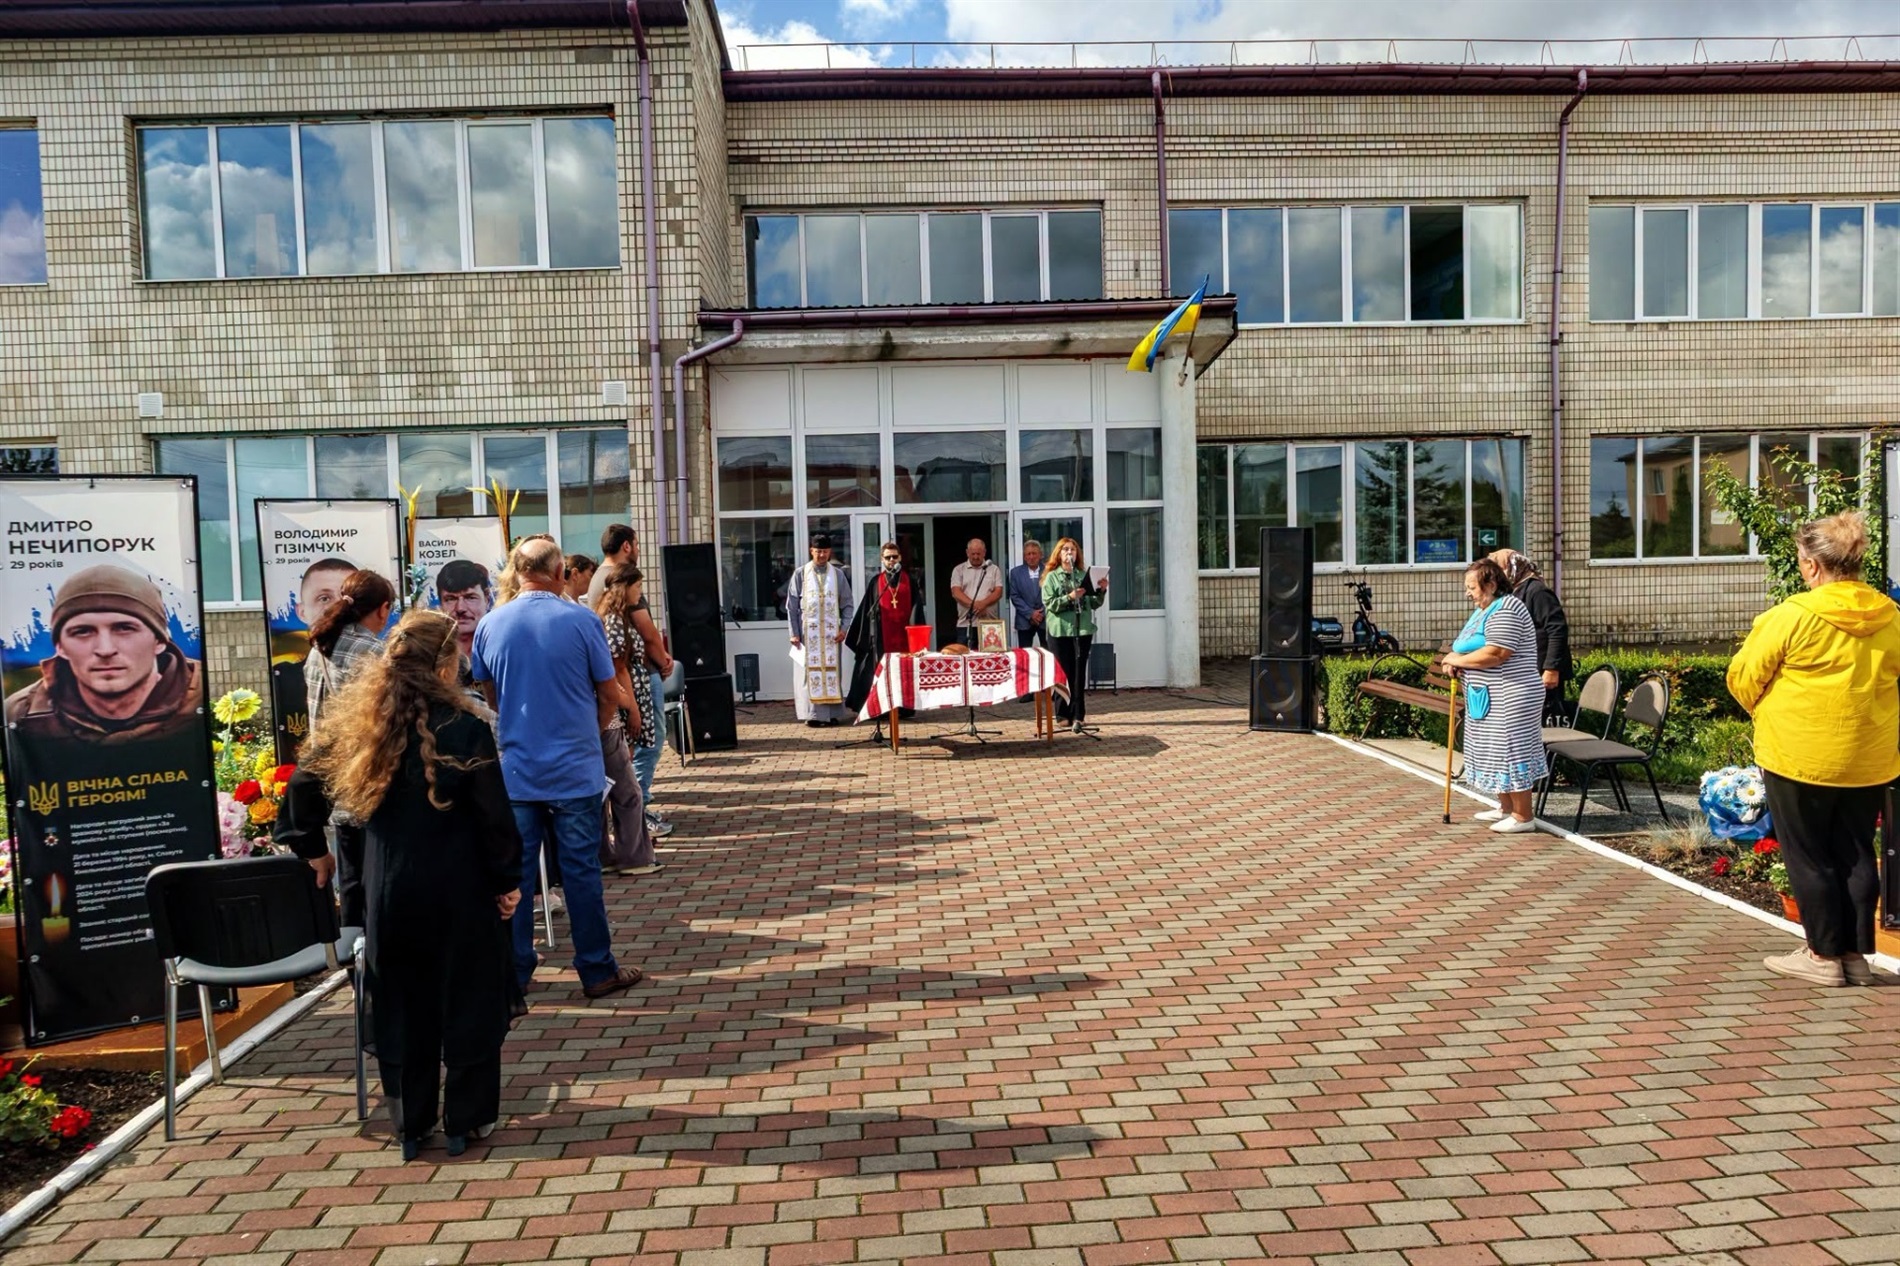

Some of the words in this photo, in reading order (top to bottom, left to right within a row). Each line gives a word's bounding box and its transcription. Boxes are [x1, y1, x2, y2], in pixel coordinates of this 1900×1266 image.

[8, 520, 92, 535] ДМИТРО
[274, 528, 358, 540] ВОЛОДИМИР
[9, 537, 155, 555] НЕЧИПОРУК
[275, 542, 346, 553] ГІЗІМЧУК
[419, 550, 456, 558] КОЗЕЛ
[10, 561, 25, 569] 29
[29, 560, 64, 570] років
[67, 777, 122, 792] ВІЧНА
[127, 770, 188, 786] СЛАВА
[68, 788, 146, 808] ГЕРОЯМ!
